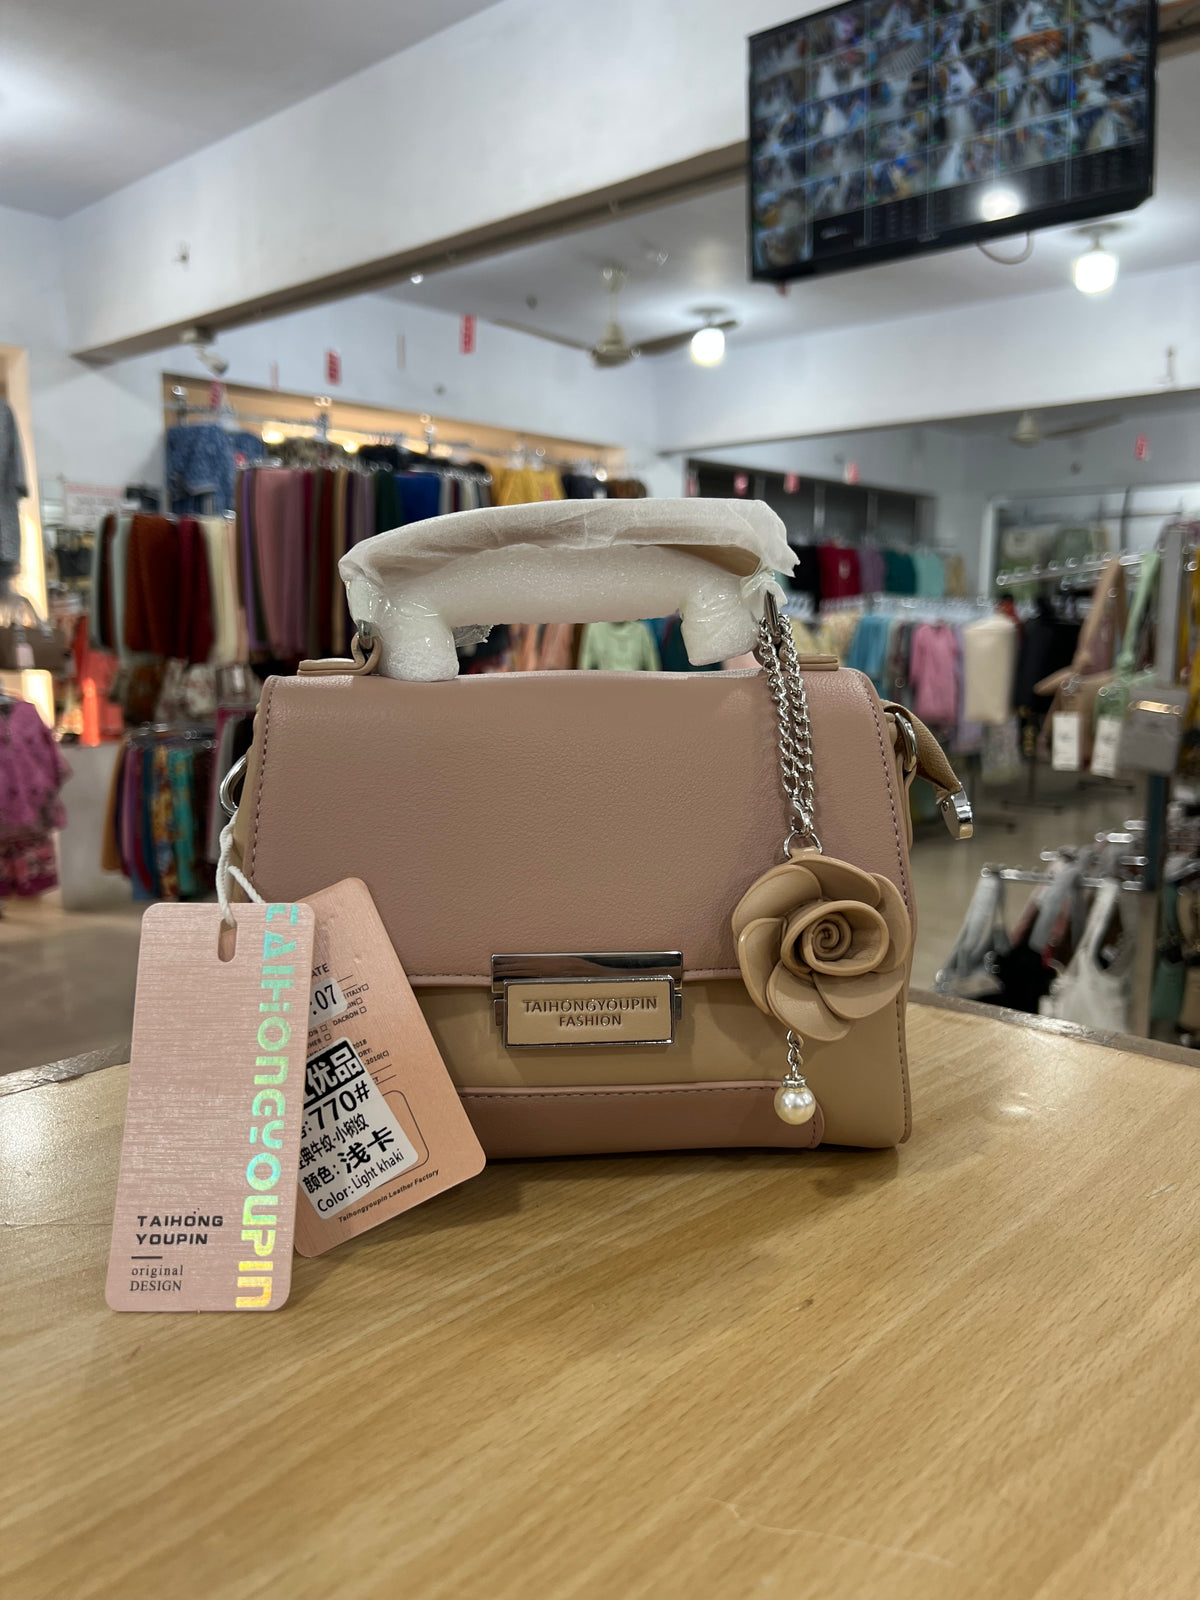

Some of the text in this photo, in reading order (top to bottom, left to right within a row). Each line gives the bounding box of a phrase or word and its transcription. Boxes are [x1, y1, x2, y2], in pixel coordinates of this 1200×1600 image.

[524, 997, 657, 1012] TAIHONGYOUPIN
[333, 1010, 359, 1026] DACRON
[559, 1015, 622, 1027] FASHION
[317, 1148, 404, 1212] Color: Light khaki
[388, 1181, 414, 1198] Leather
[415, 1169, 439, 1186] Factory
[137, 1215, 224, 1227] TAIHONG
[136, 1233, 208, 1245] YOUPIN
[131, 1264, 184, 1279] original
[129, 1280, 182, 1292] DESIGN
